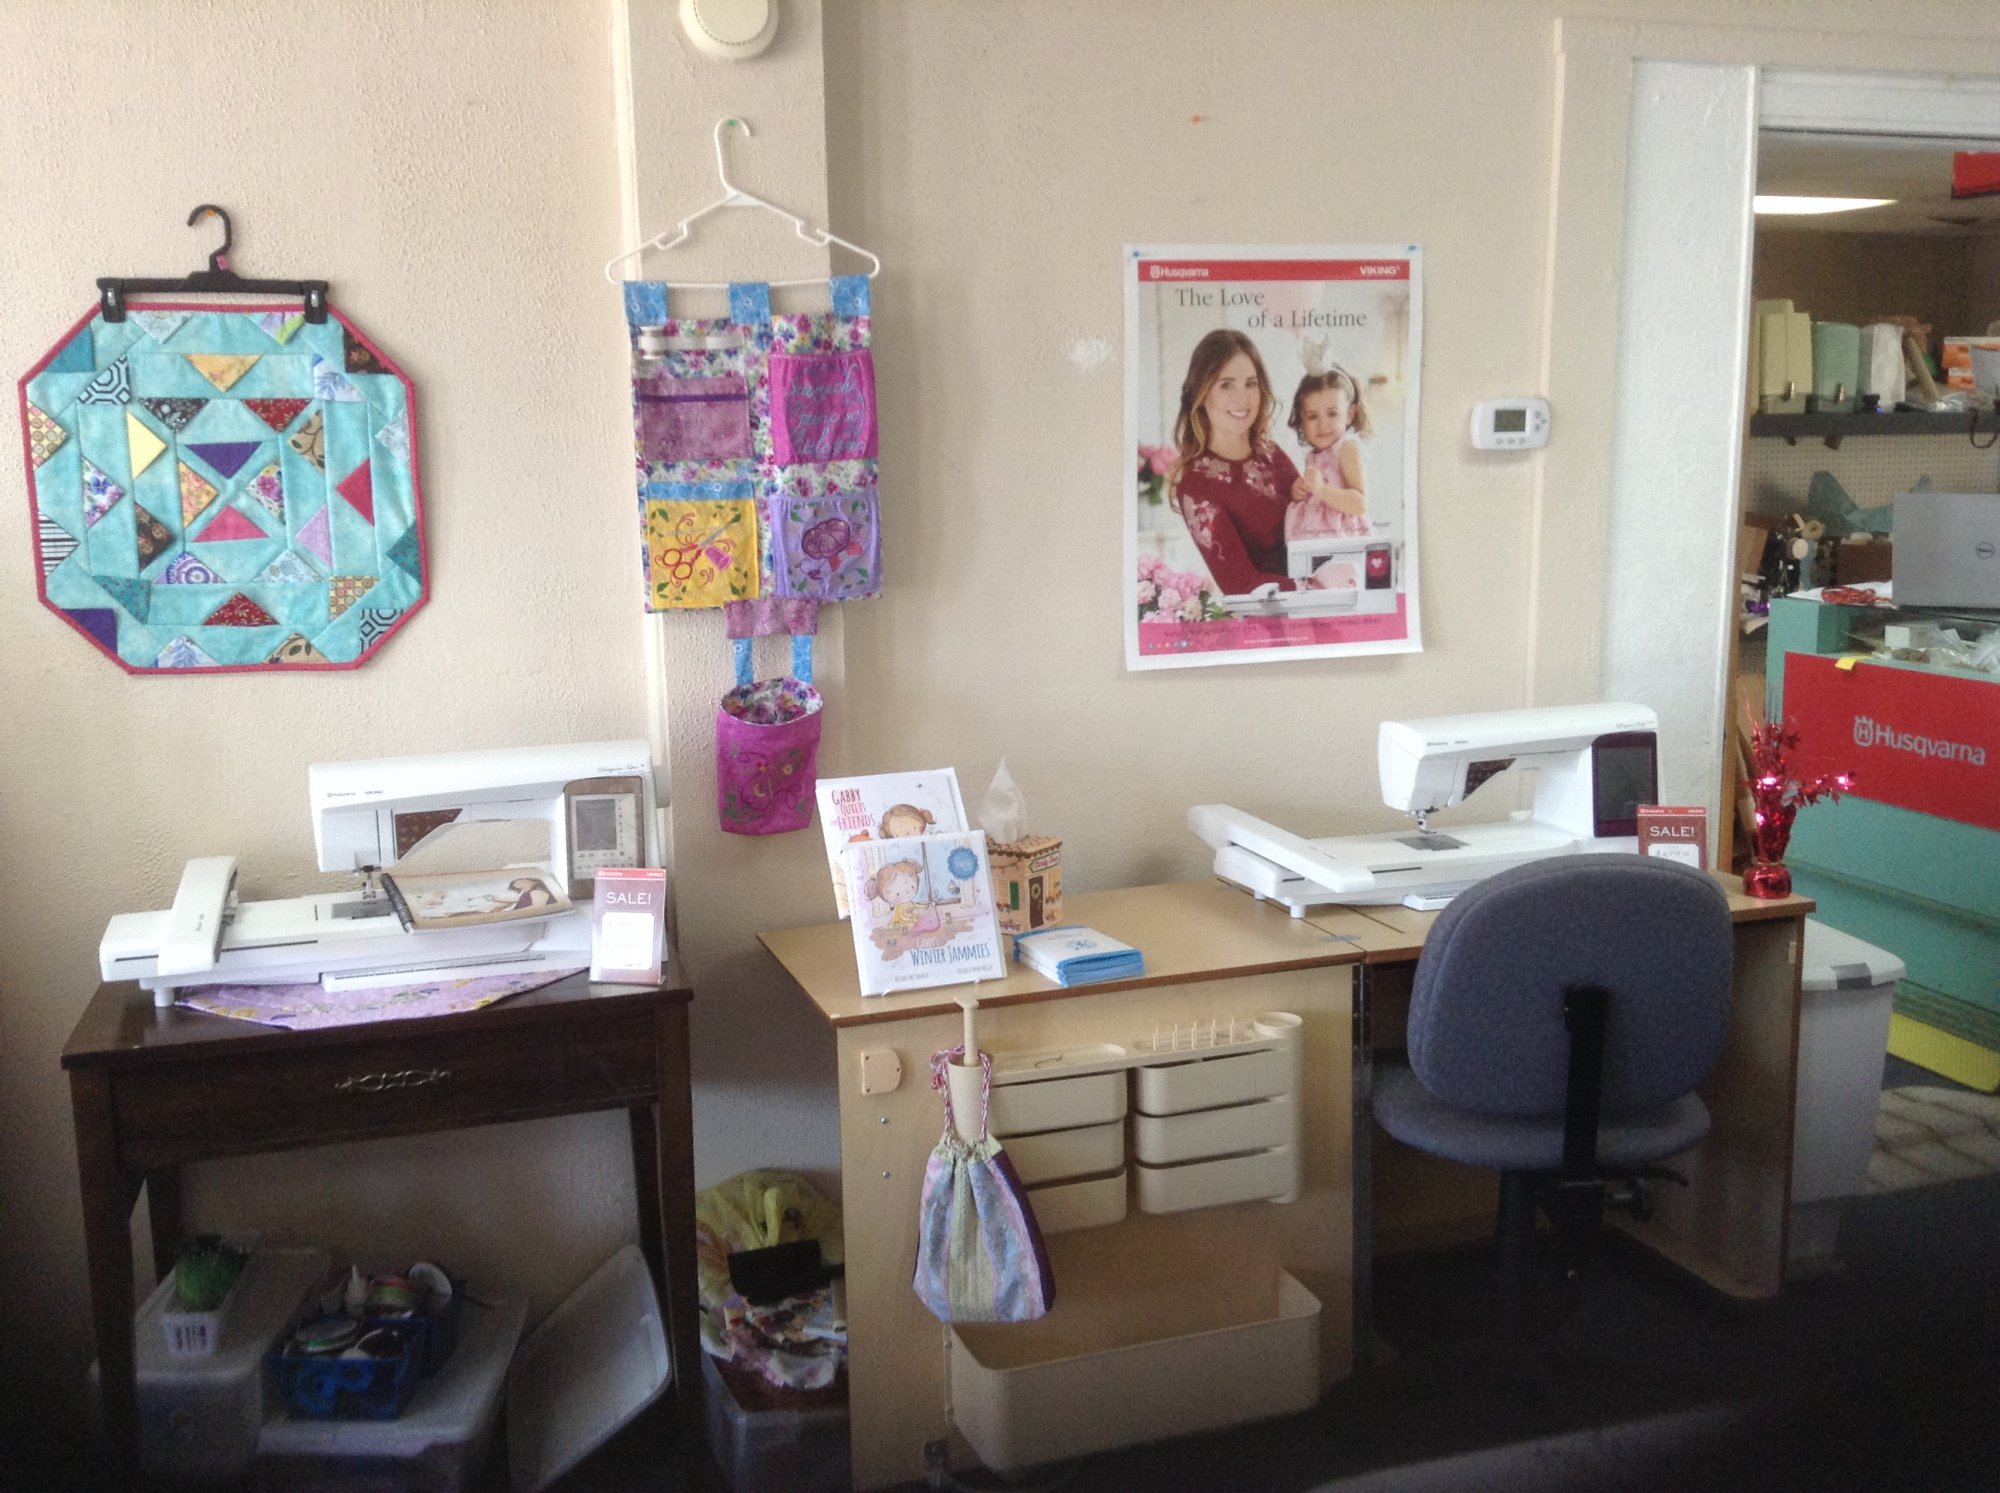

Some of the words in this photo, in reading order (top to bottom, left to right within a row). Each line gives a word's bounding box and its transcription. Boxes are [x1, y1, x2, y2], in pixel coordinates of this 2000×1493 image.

[1160, 265, 1209, 279] Husqvarna
[1360, 265, 1397, 276] VIKING
[1175, 288, 1214, 307] The
[1220, 288, 1265, 307] Love
[1248, 308, 1269, 328] of
[1273, 314, 1284, 328] a
[1291, 309, 1368, 328] Lifetime
[1874, 722, 1987, 768] Husqvarna
[831, 788, 861, 805] GABBY
[840, 801, 867, 816] QUILTS
[837, 814, 876, 830] FRIENDS
[1649, 825, 1695, 838] SALE!
[606, 890, 652, 906] SALE!
[911, 946, 948, 967] WINTER
[947, 941, 991, 964] JAMMIES
